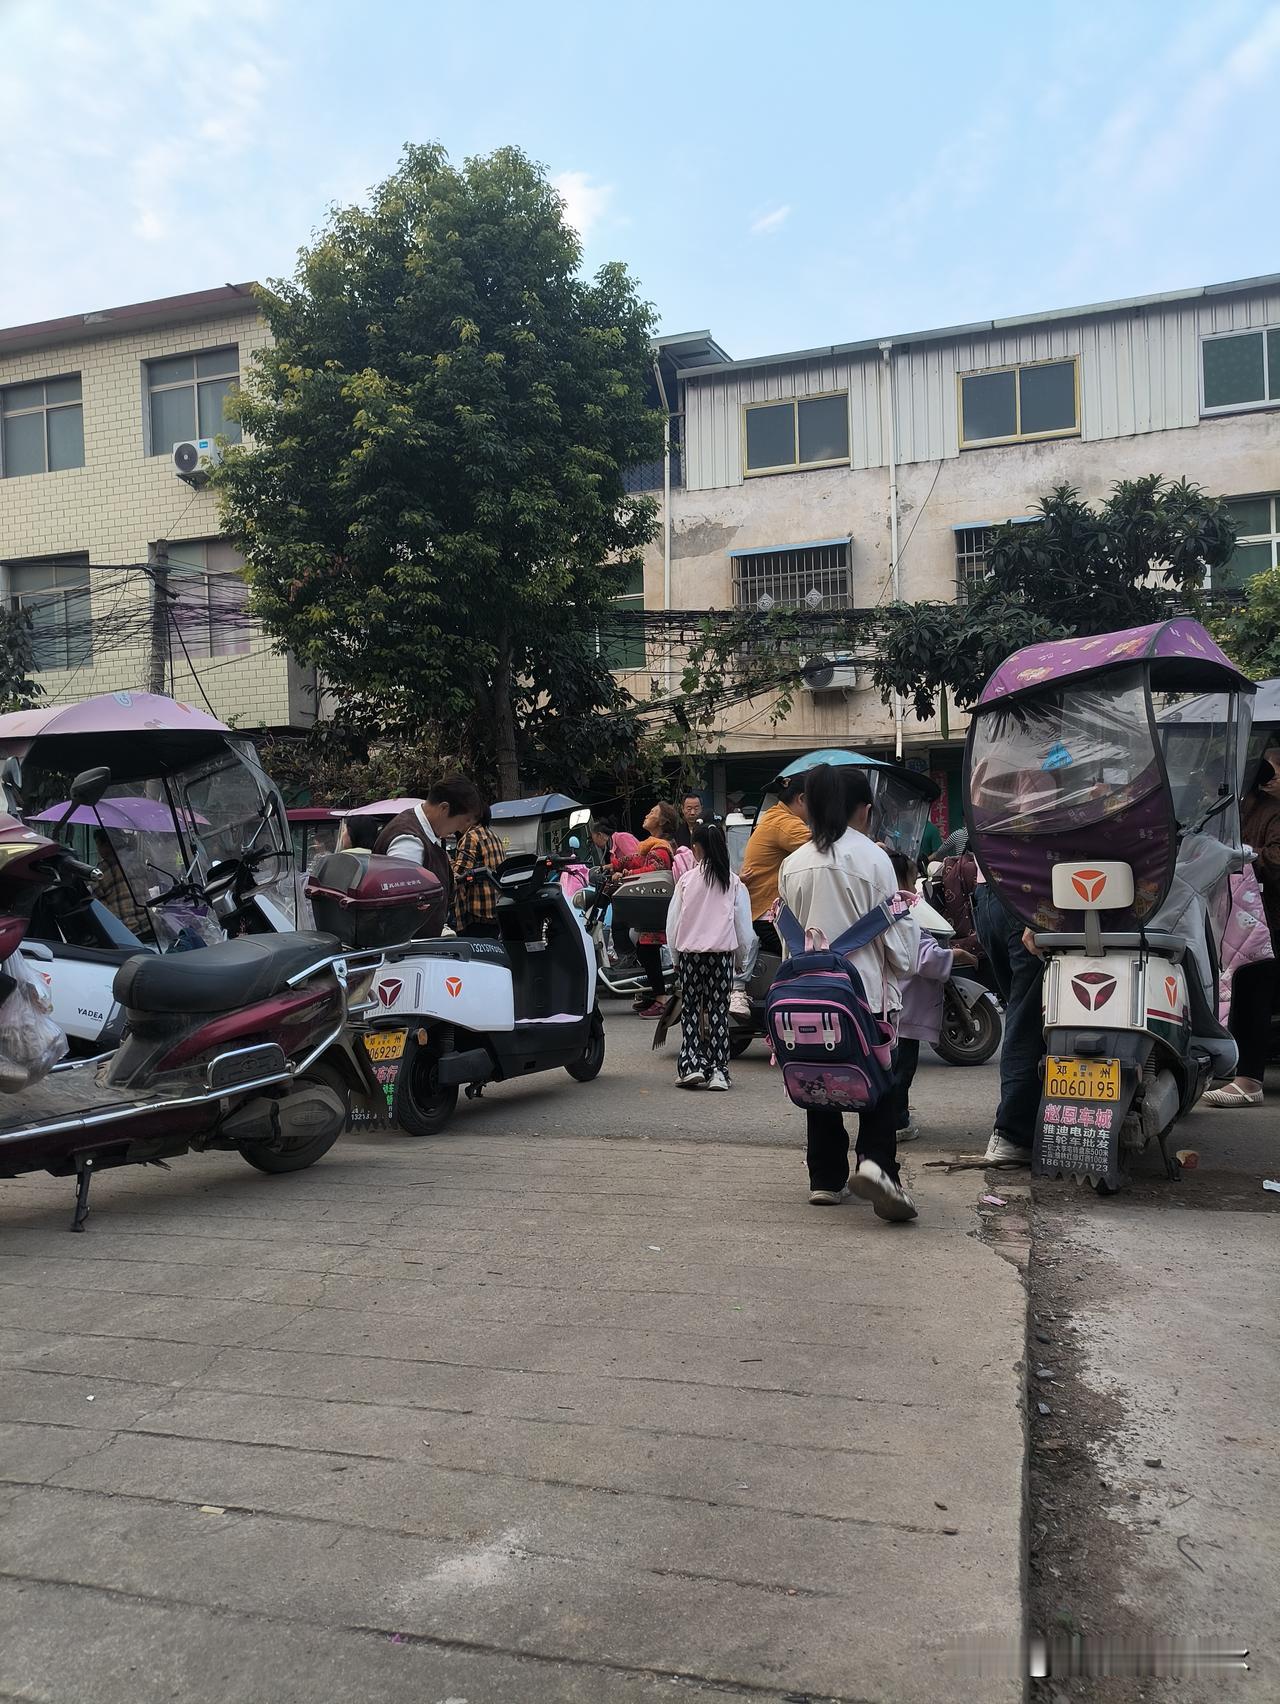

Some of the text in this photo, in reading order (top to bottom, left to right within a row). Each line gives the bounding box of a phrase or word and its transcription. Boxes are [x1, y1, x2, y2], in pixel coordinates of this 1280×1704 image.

[77, 1007, 103, 1020] YADEA
[368, 1045, 401, 1060] 069290
[371, 1065, 399, 1084] 车行
[1100, 1068, 1111, 1079] 州
[1050, 1079, 1115, 1098] 0060195
[1043, 1103, 1113, 1129] 赵恩车城
[1042, 1123, 1111, 1140] 雅迪电动车
[1041, 1134, 1110, 1150] 三轮车批发
[1041, 1157, 1109, 1173] 18613771123
